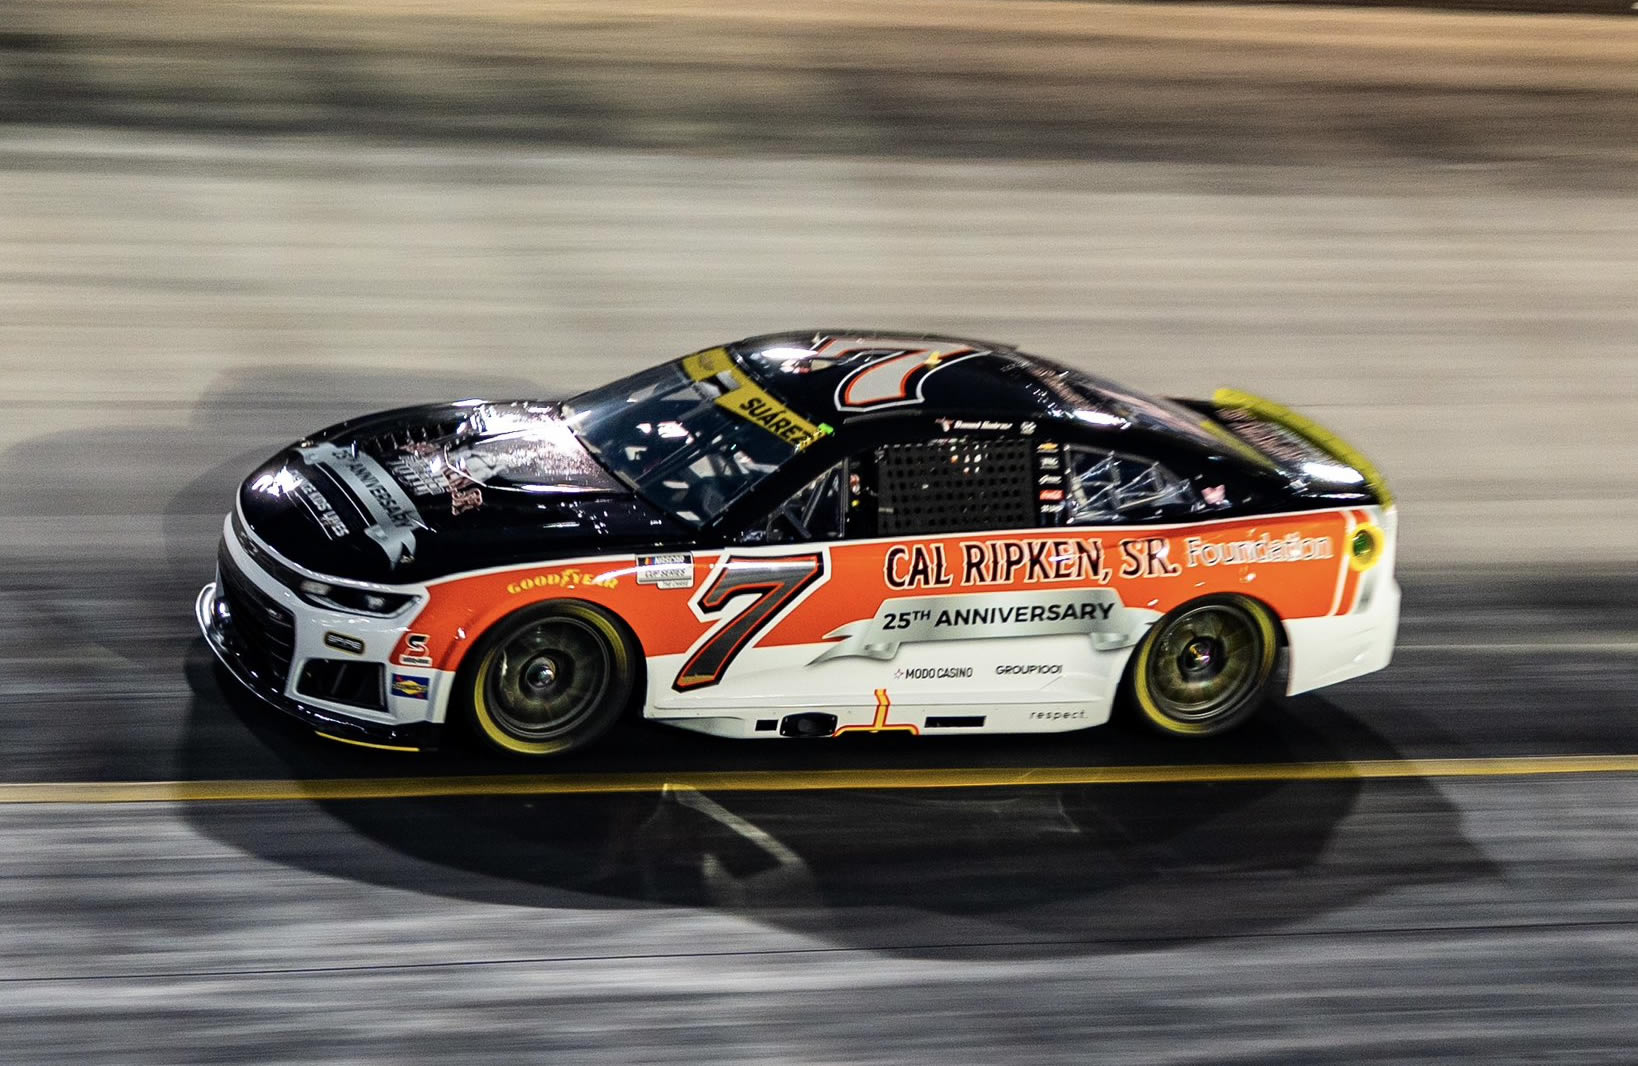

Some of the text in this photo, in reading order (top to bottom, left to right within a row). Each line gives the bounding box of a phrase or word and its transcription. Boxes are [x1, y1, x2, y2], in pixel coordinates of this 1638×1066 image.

[884, 544, 953, 591] CAL
[959, 537, 1112, 585] RIPKEN,
[1184, 531, 1334, 568] Foundation
[672, 551, 831, 693] 7
[934, 602, 1114, 627] ANNIVERSARY
[905, 667, 973, 679] MODO CASINO
